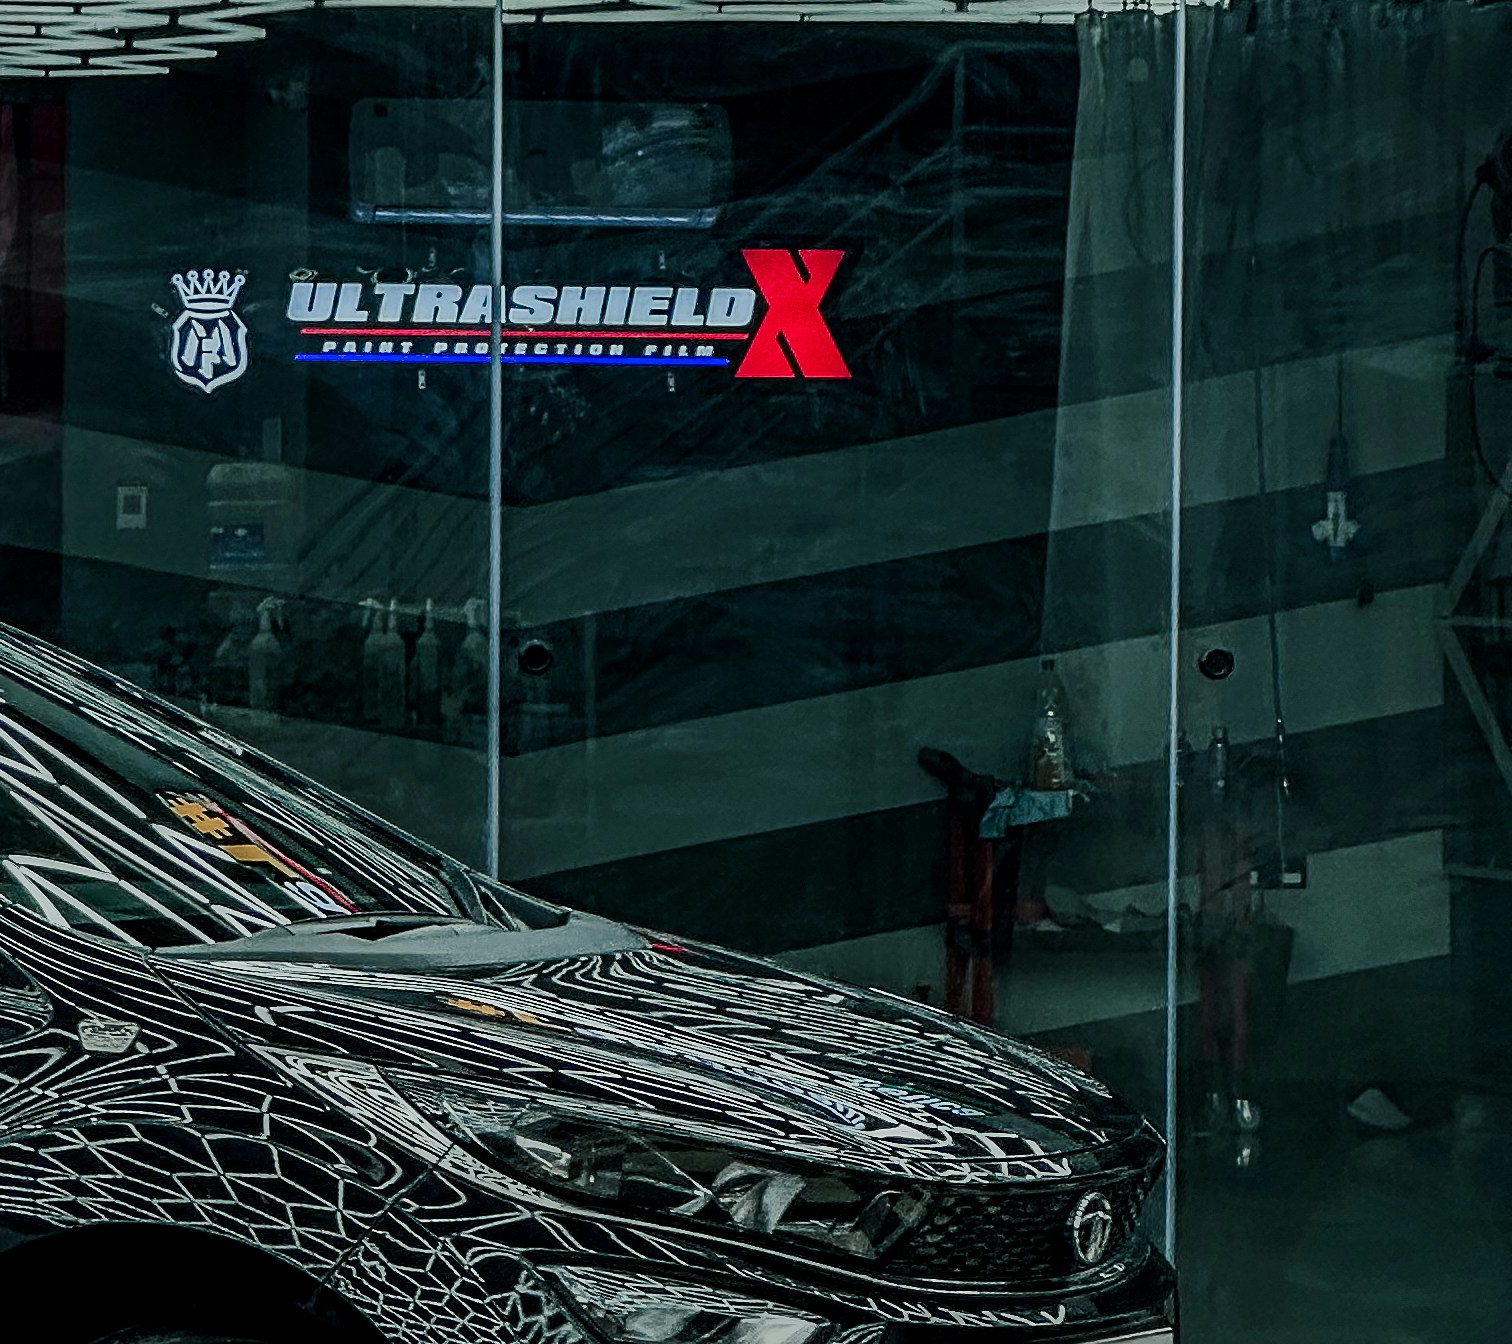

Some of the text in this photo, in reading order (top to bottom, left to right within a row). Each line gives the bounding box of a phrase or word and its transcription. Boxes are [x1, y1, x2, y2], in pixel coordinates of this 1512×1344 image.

[321, 340, 716, 358] PAINT PROTECTION FILM
